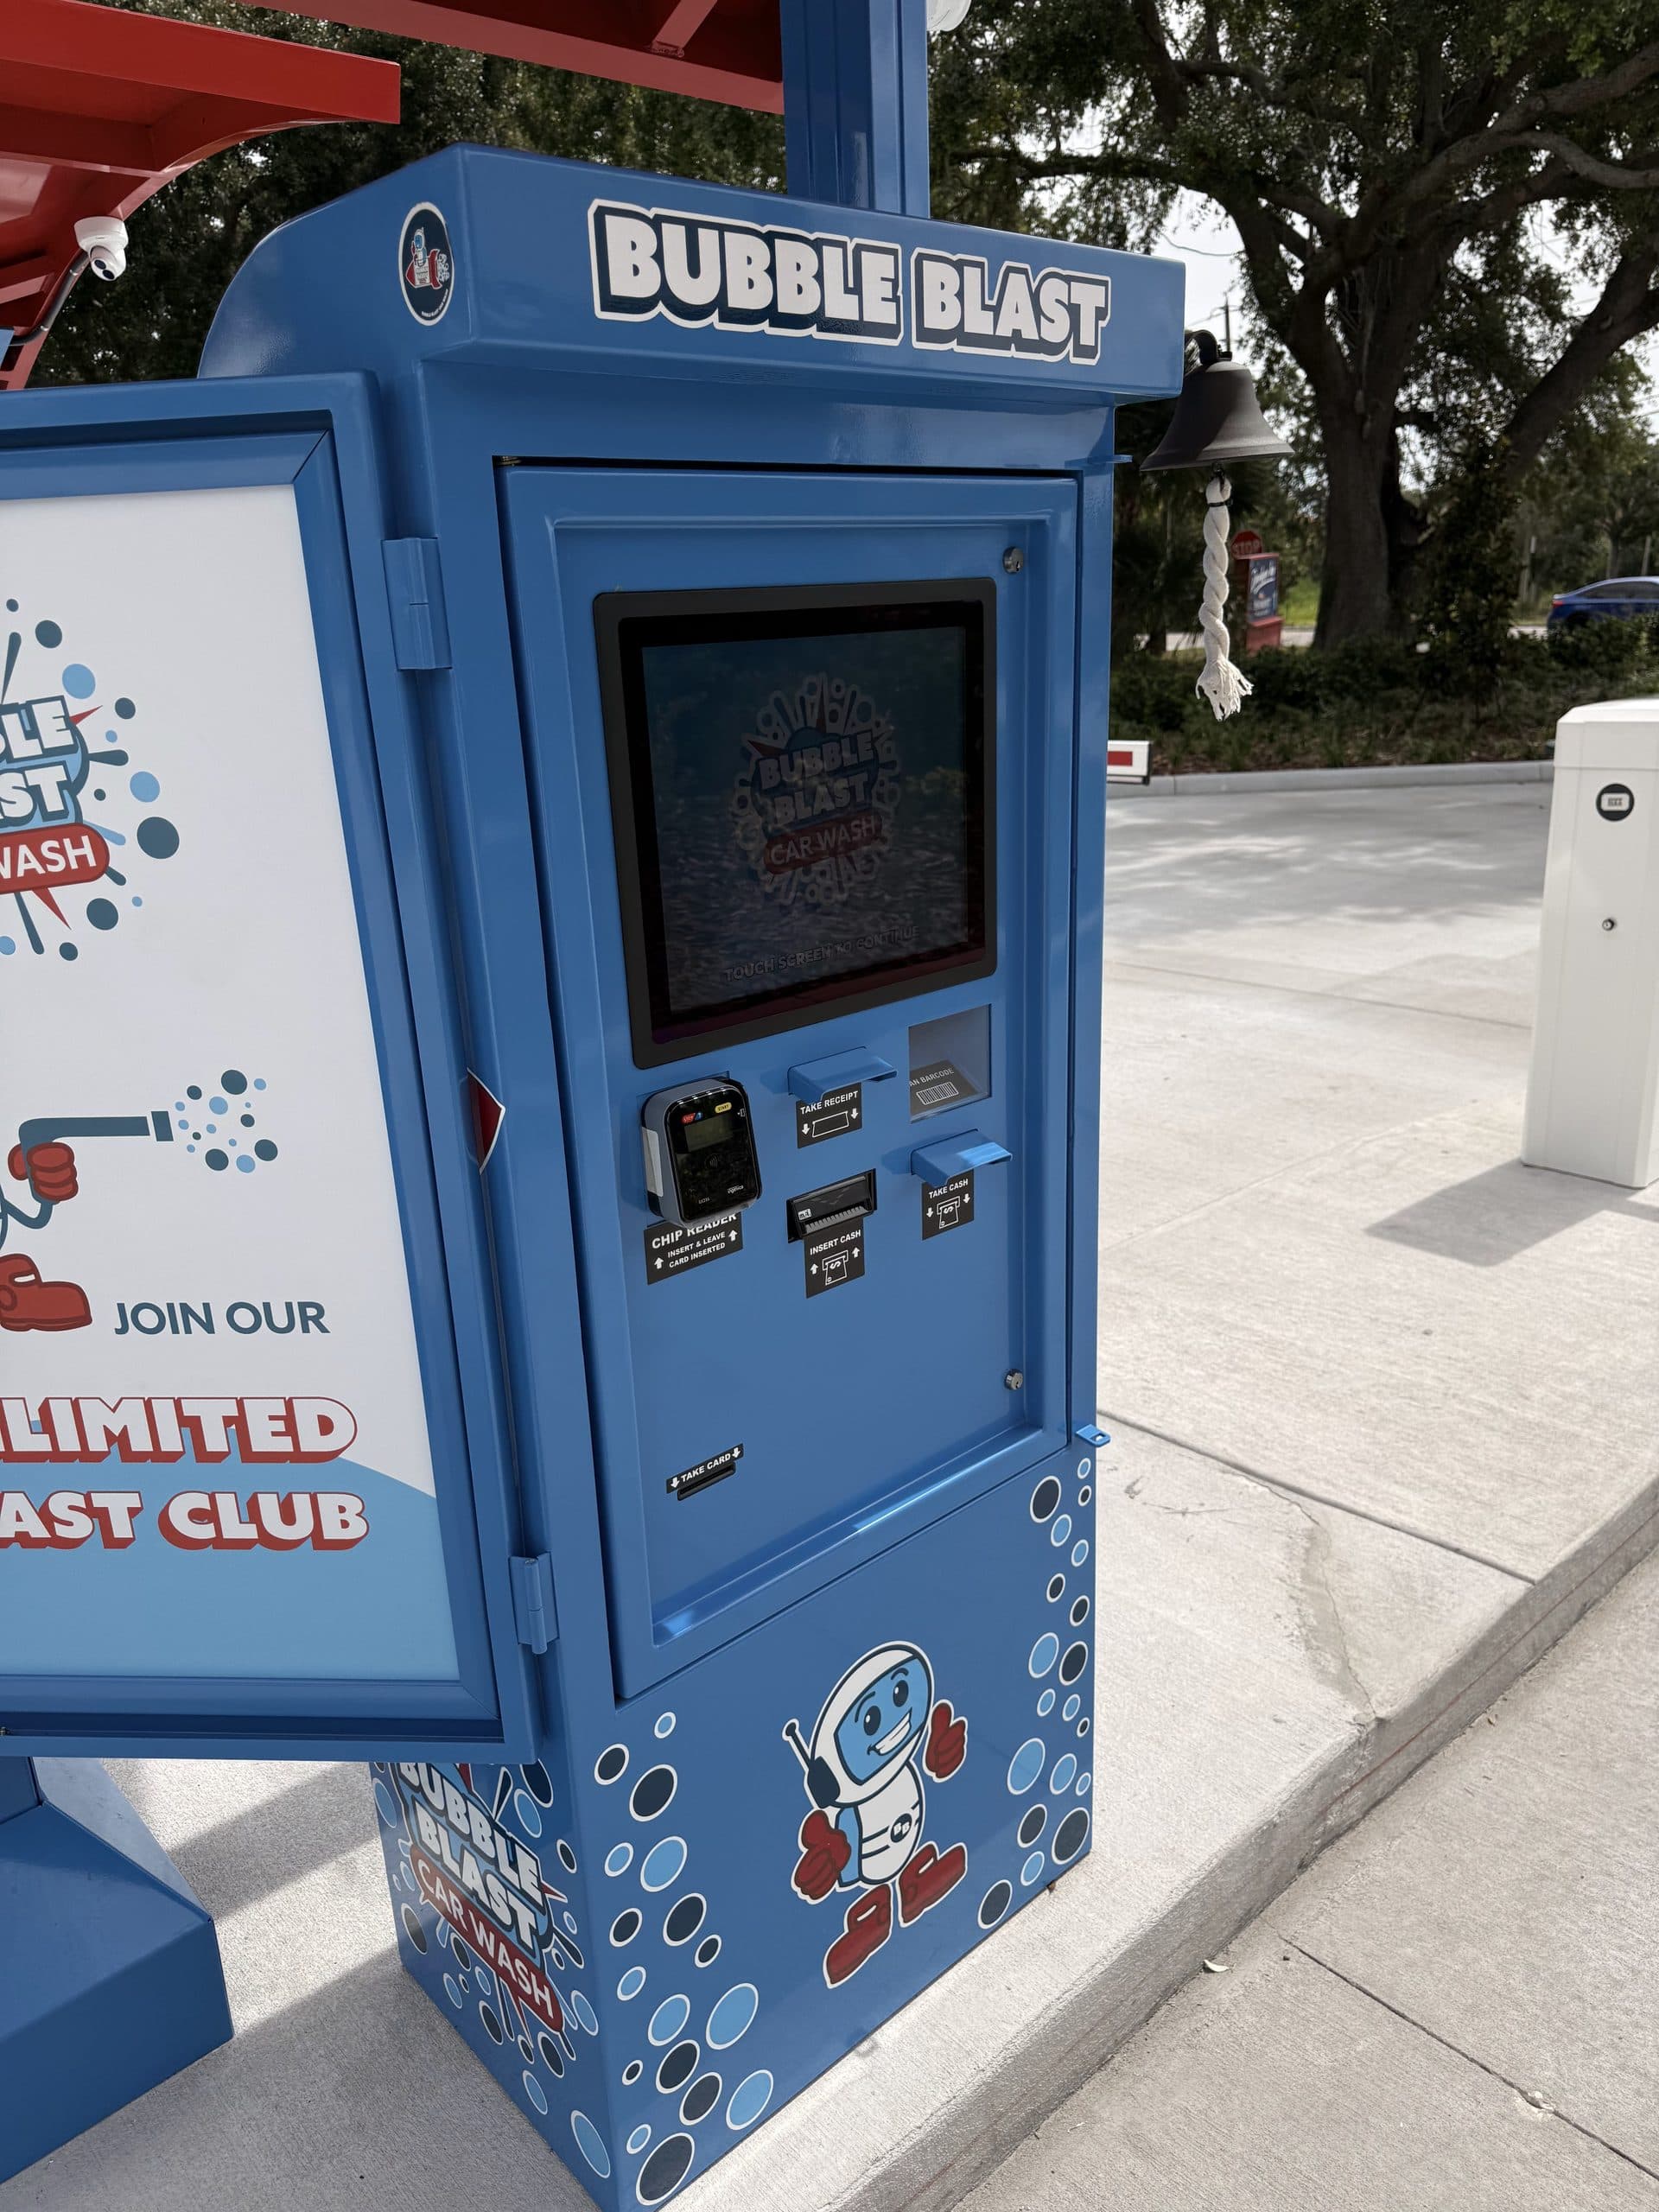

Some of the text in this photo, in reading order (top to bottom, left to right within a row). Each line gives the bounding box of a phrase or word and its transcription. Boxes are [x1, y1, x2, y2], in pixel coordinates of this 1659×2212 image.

[596, 207, 1109, 356] BUBBLE BLAST
[0, 698, 77, 760] LE
[758, 730, 875, 790] BUBBLE
[0, 762, 69, 821] ST
[772, 773, 869, 826] BLAST
[769, 816, 877, 865] CAR WASH
[724, 957, 775, 983] TOUCH
[778, 943, 837, 970] SCREEN
[856, 925, 920, 951] CONTINUE
[919, 1068, 955, 1084] BARCODE
[800, 1090, 859, 1115] TAKE RECEIPT
[928, 1178, 969, 1199] TAKE CASH
[652, 1230, 683, 1249] CHIP
[667, 1231, 726, 1258] INSERT & LEAVE
[669, 1242, 726, 1268] CARD INSERTED
[810, 1229, 861, 1255] INSERT CASH
[114, 1300, 331, 1335] JOIN OUR
[0, 1396, 357, 1463] LIMITED
[681, 1452, 731, 1482] TAKE CARD
[158, 1491, 370, 1550] CLUB
[413, 1798, 538, 1951] BLAST
[417, 1859, 555, 2018] CAR WASH
